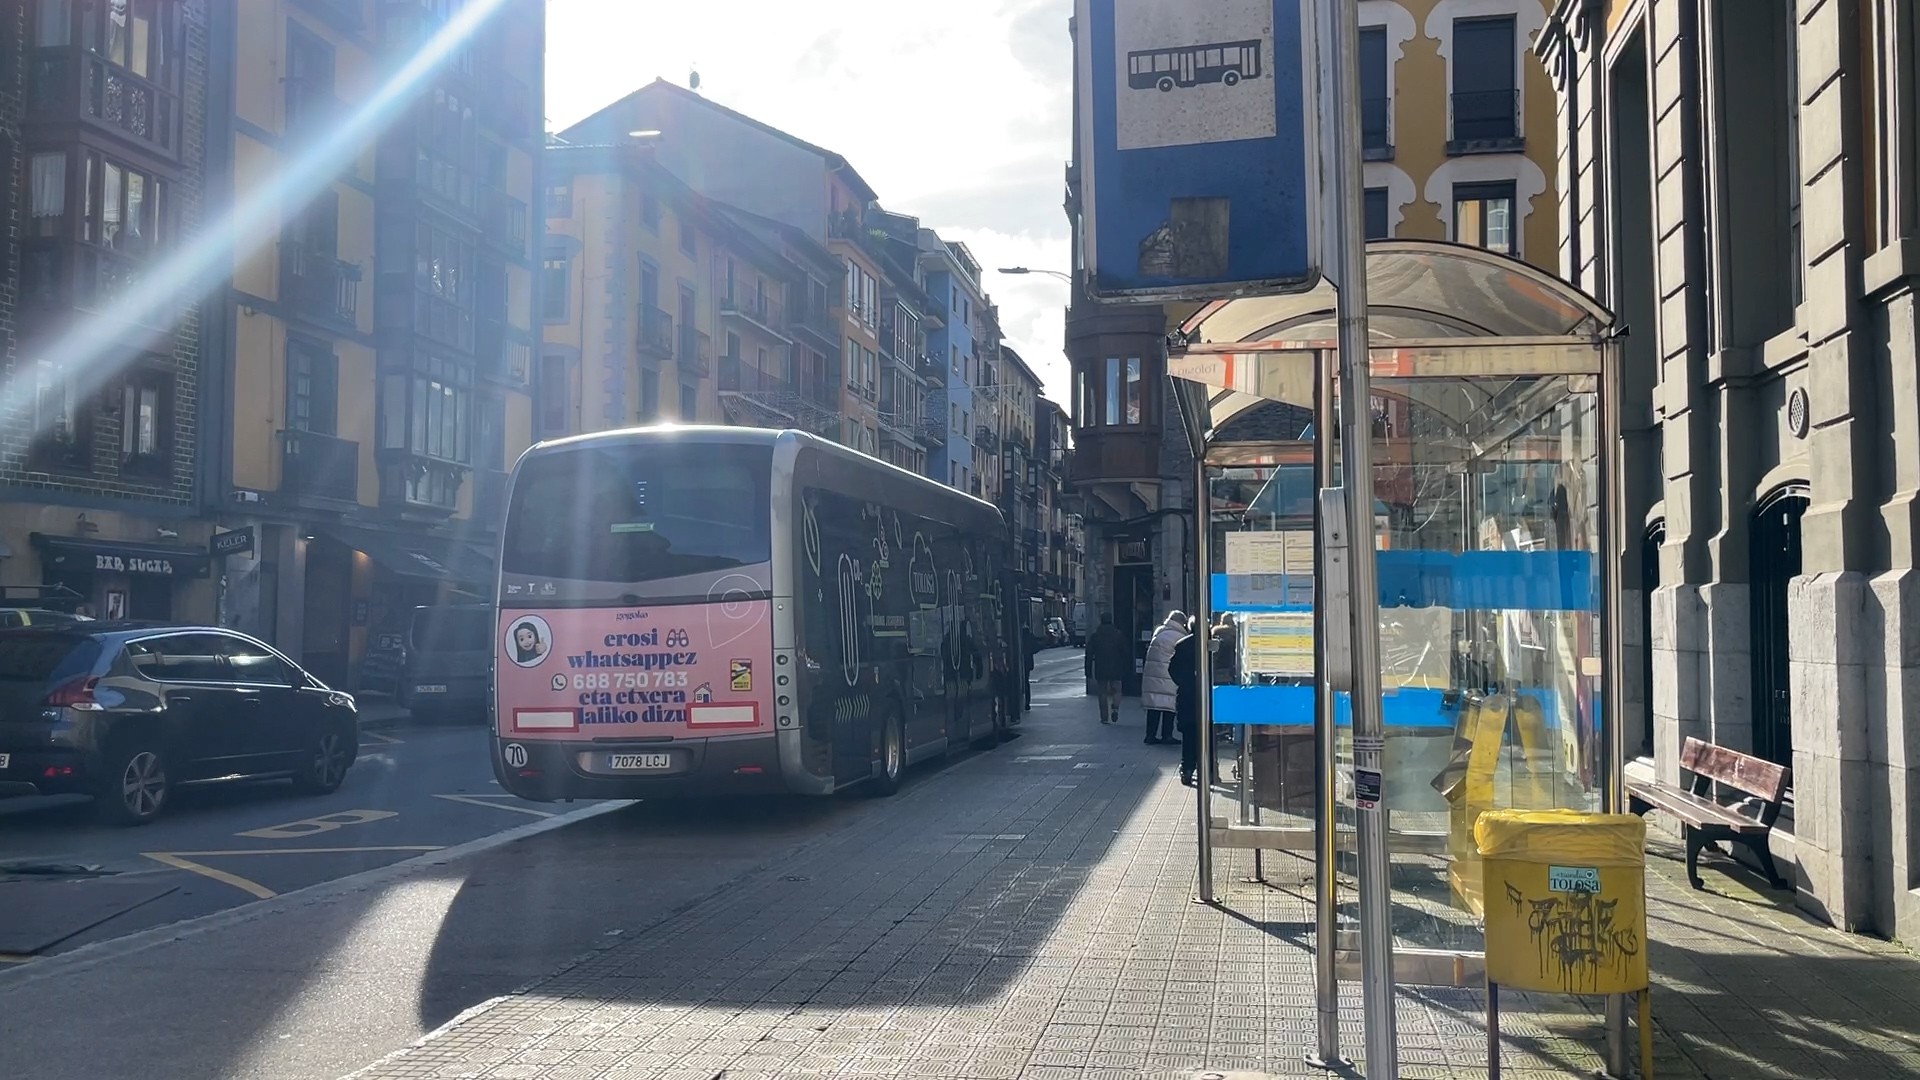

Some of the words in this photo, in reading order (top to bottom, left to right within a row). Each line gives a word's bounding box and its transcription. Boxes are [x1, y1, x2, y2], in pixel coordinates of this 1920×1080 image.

[216, 535, 248, 549] KELER
[95, 554, 125, 572] BAR
[129, 558, 173, 574] SUGAR
[604, 628, 658, 647] erosi
[567, 650, 698, 670] whatsappez
[573, 672, 609, 689] 688
[614, 671, 649, 688] 750
[653, 671, 688, 687] 783
[579, 689, 612, 705] eta
[616, 687, 686, 704] etxera
[642, 705, 687, 723] dizu
[508, 746, 525, 765] 70
[614, 756, 642, 767] 7078
[646, 755, 667, 767] LCJ
